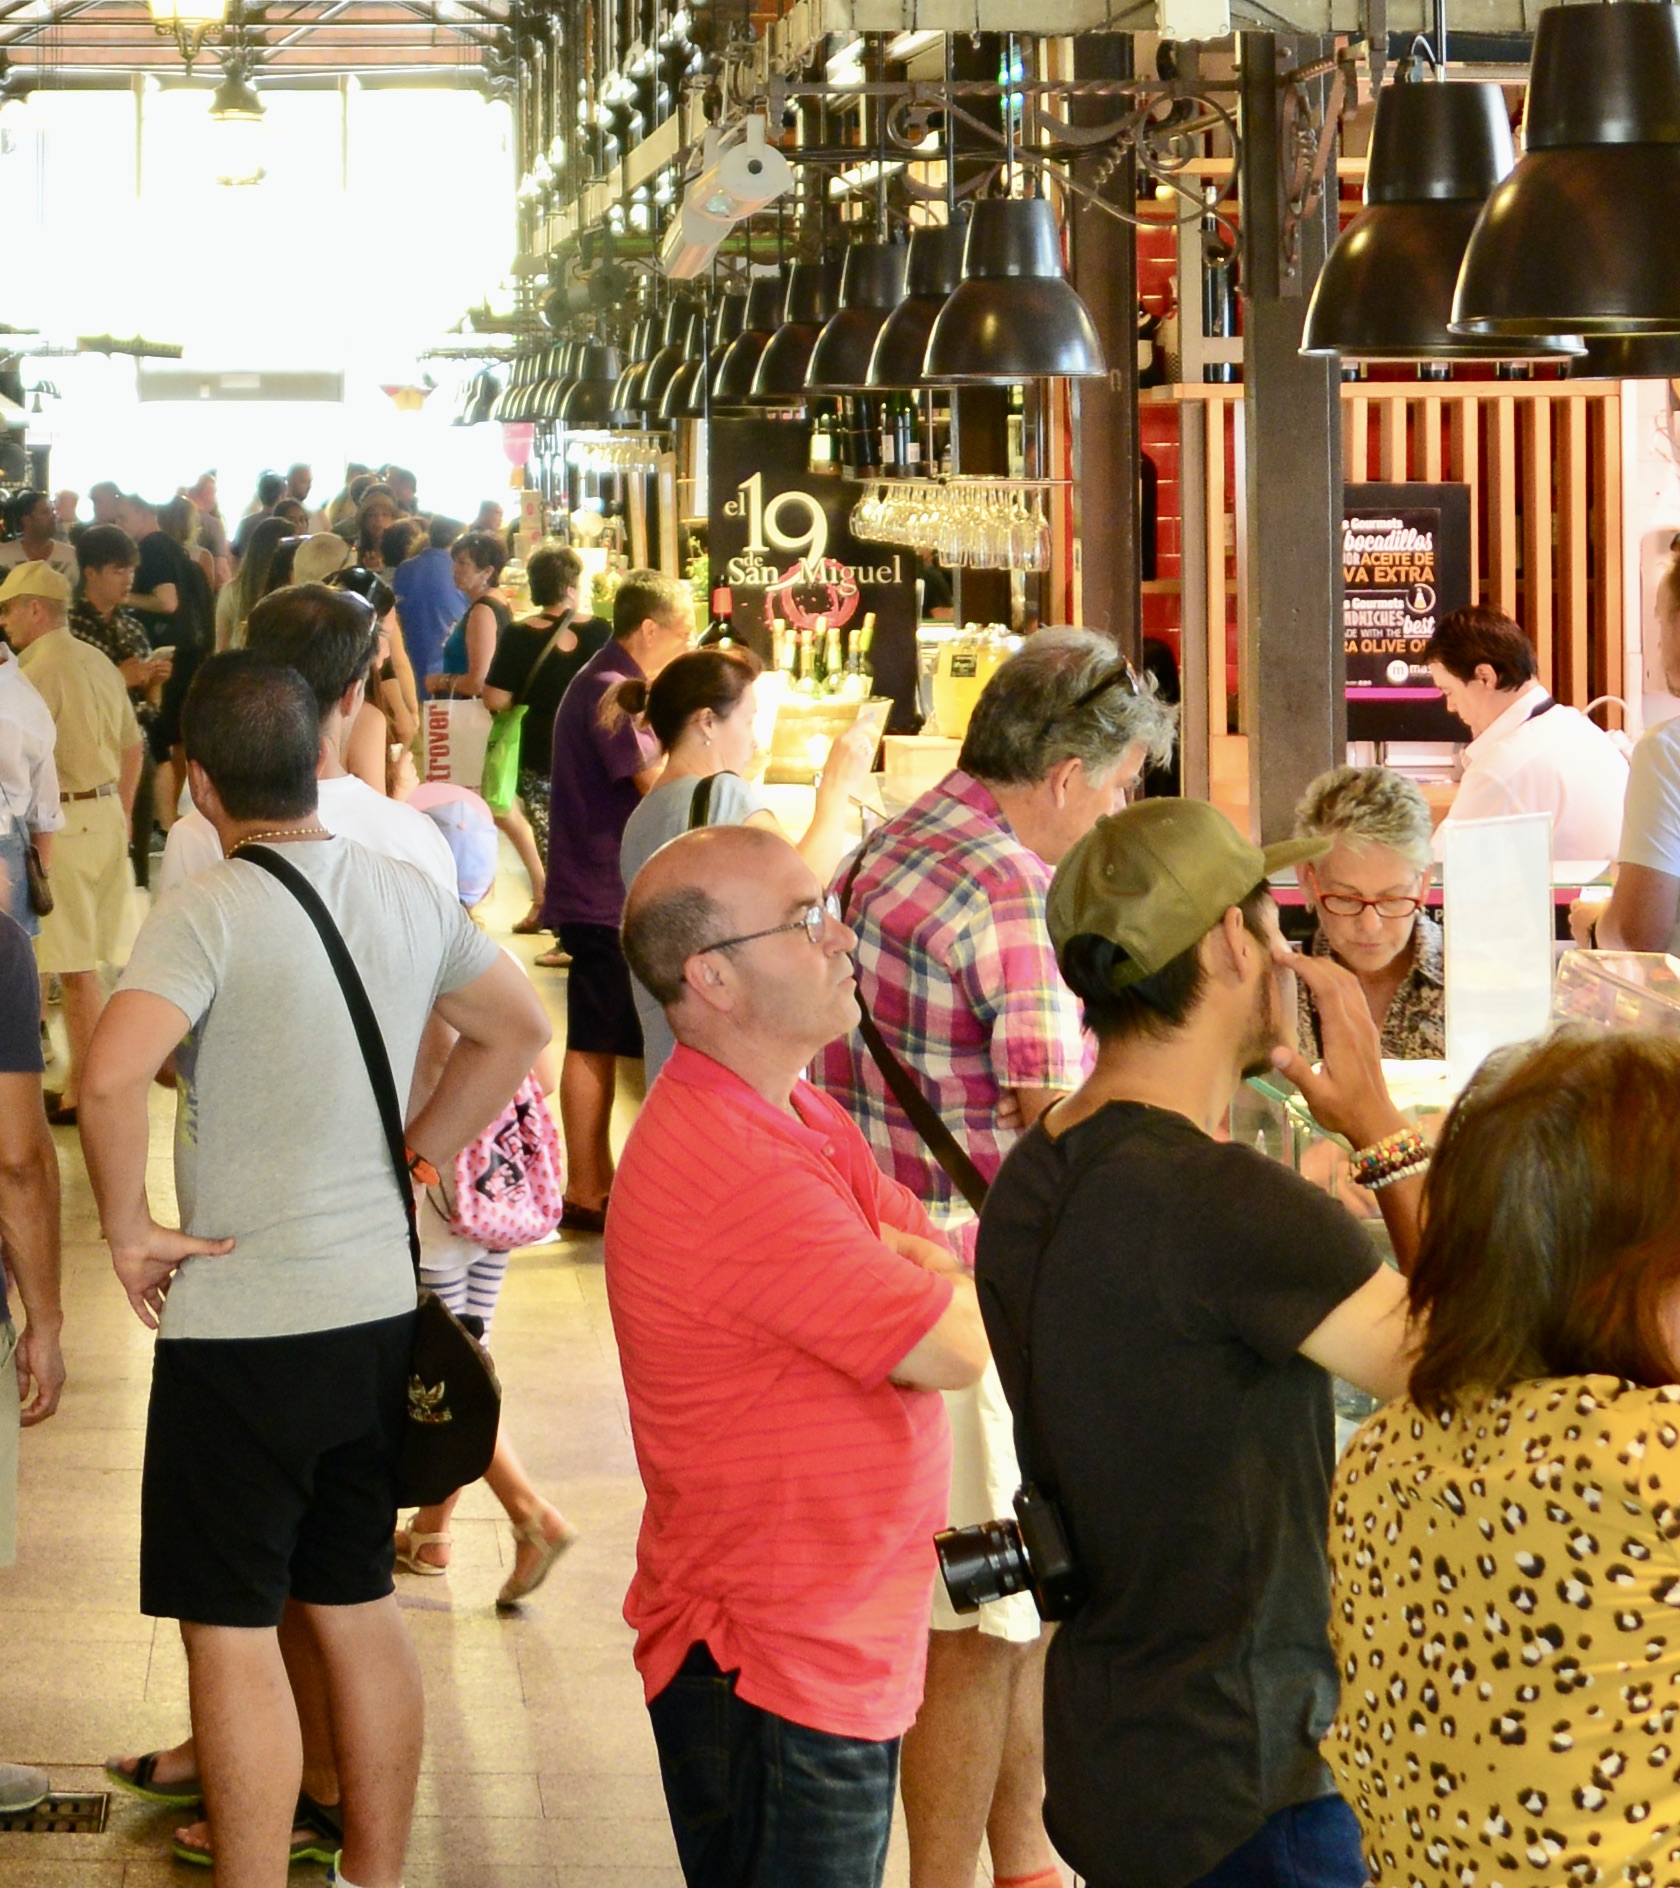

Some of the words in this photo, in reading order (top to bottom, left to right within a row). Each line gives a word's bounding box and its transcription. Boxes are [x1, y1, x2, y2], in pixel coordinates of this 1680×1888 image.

[724, 492, 746, 517] el
[739, 471, 828, 591] 19
[1351, 517, 1404, 530] Gourmets
[1344, 528, 1434, 552] bocadillos
[742, 551, 763, 568] de
[1361, 552, 1412, 566] ACEITE
[1414, 552, 1435, 566] DE
[728, 557, 781, 586] San
[798, 555, 902, 596] Miguel
[1344, 567, 1369, 582] VA
[1374, 567, 1435, 582] EXTRA
[1352, 597, 1404, 609] Gourmets
[1403, 615, 1435, 634] best
[1361, 628, 1384, 638] WITH
[1386, 628, 1402, 638] THE
[1361, 639, 1407, 653] OLIVE
